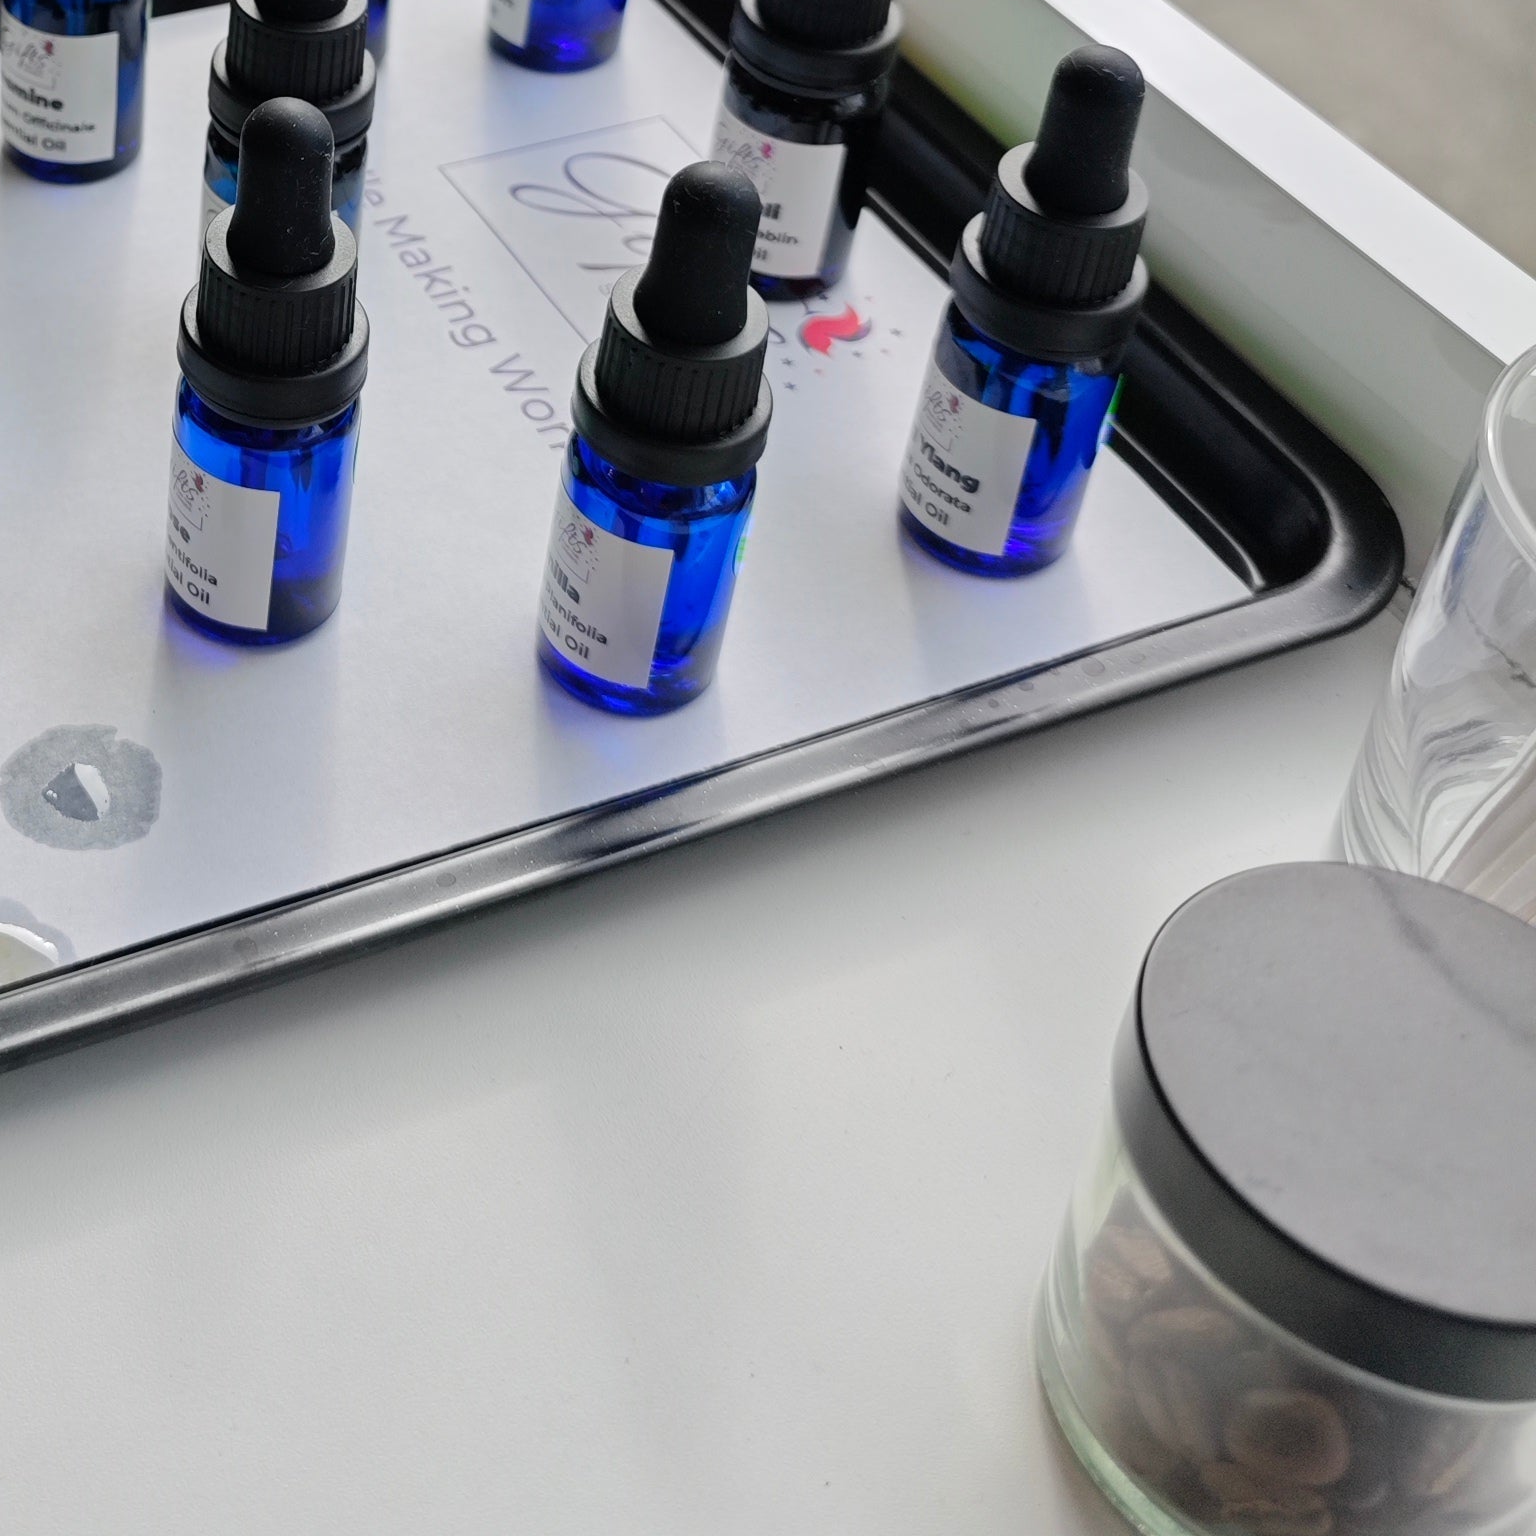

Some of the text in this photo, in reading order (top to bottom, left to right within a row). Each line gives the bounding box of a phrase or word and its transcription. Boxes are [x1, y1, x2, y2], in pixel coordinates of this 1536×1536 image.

[374, 214, 498, 349] Making
[913, 462, 972, 513] Odorata
[925, 501, 950, 527] Oil
[186, 581, 211, 606] Oil
[564, 635, 590, 659] Oil
